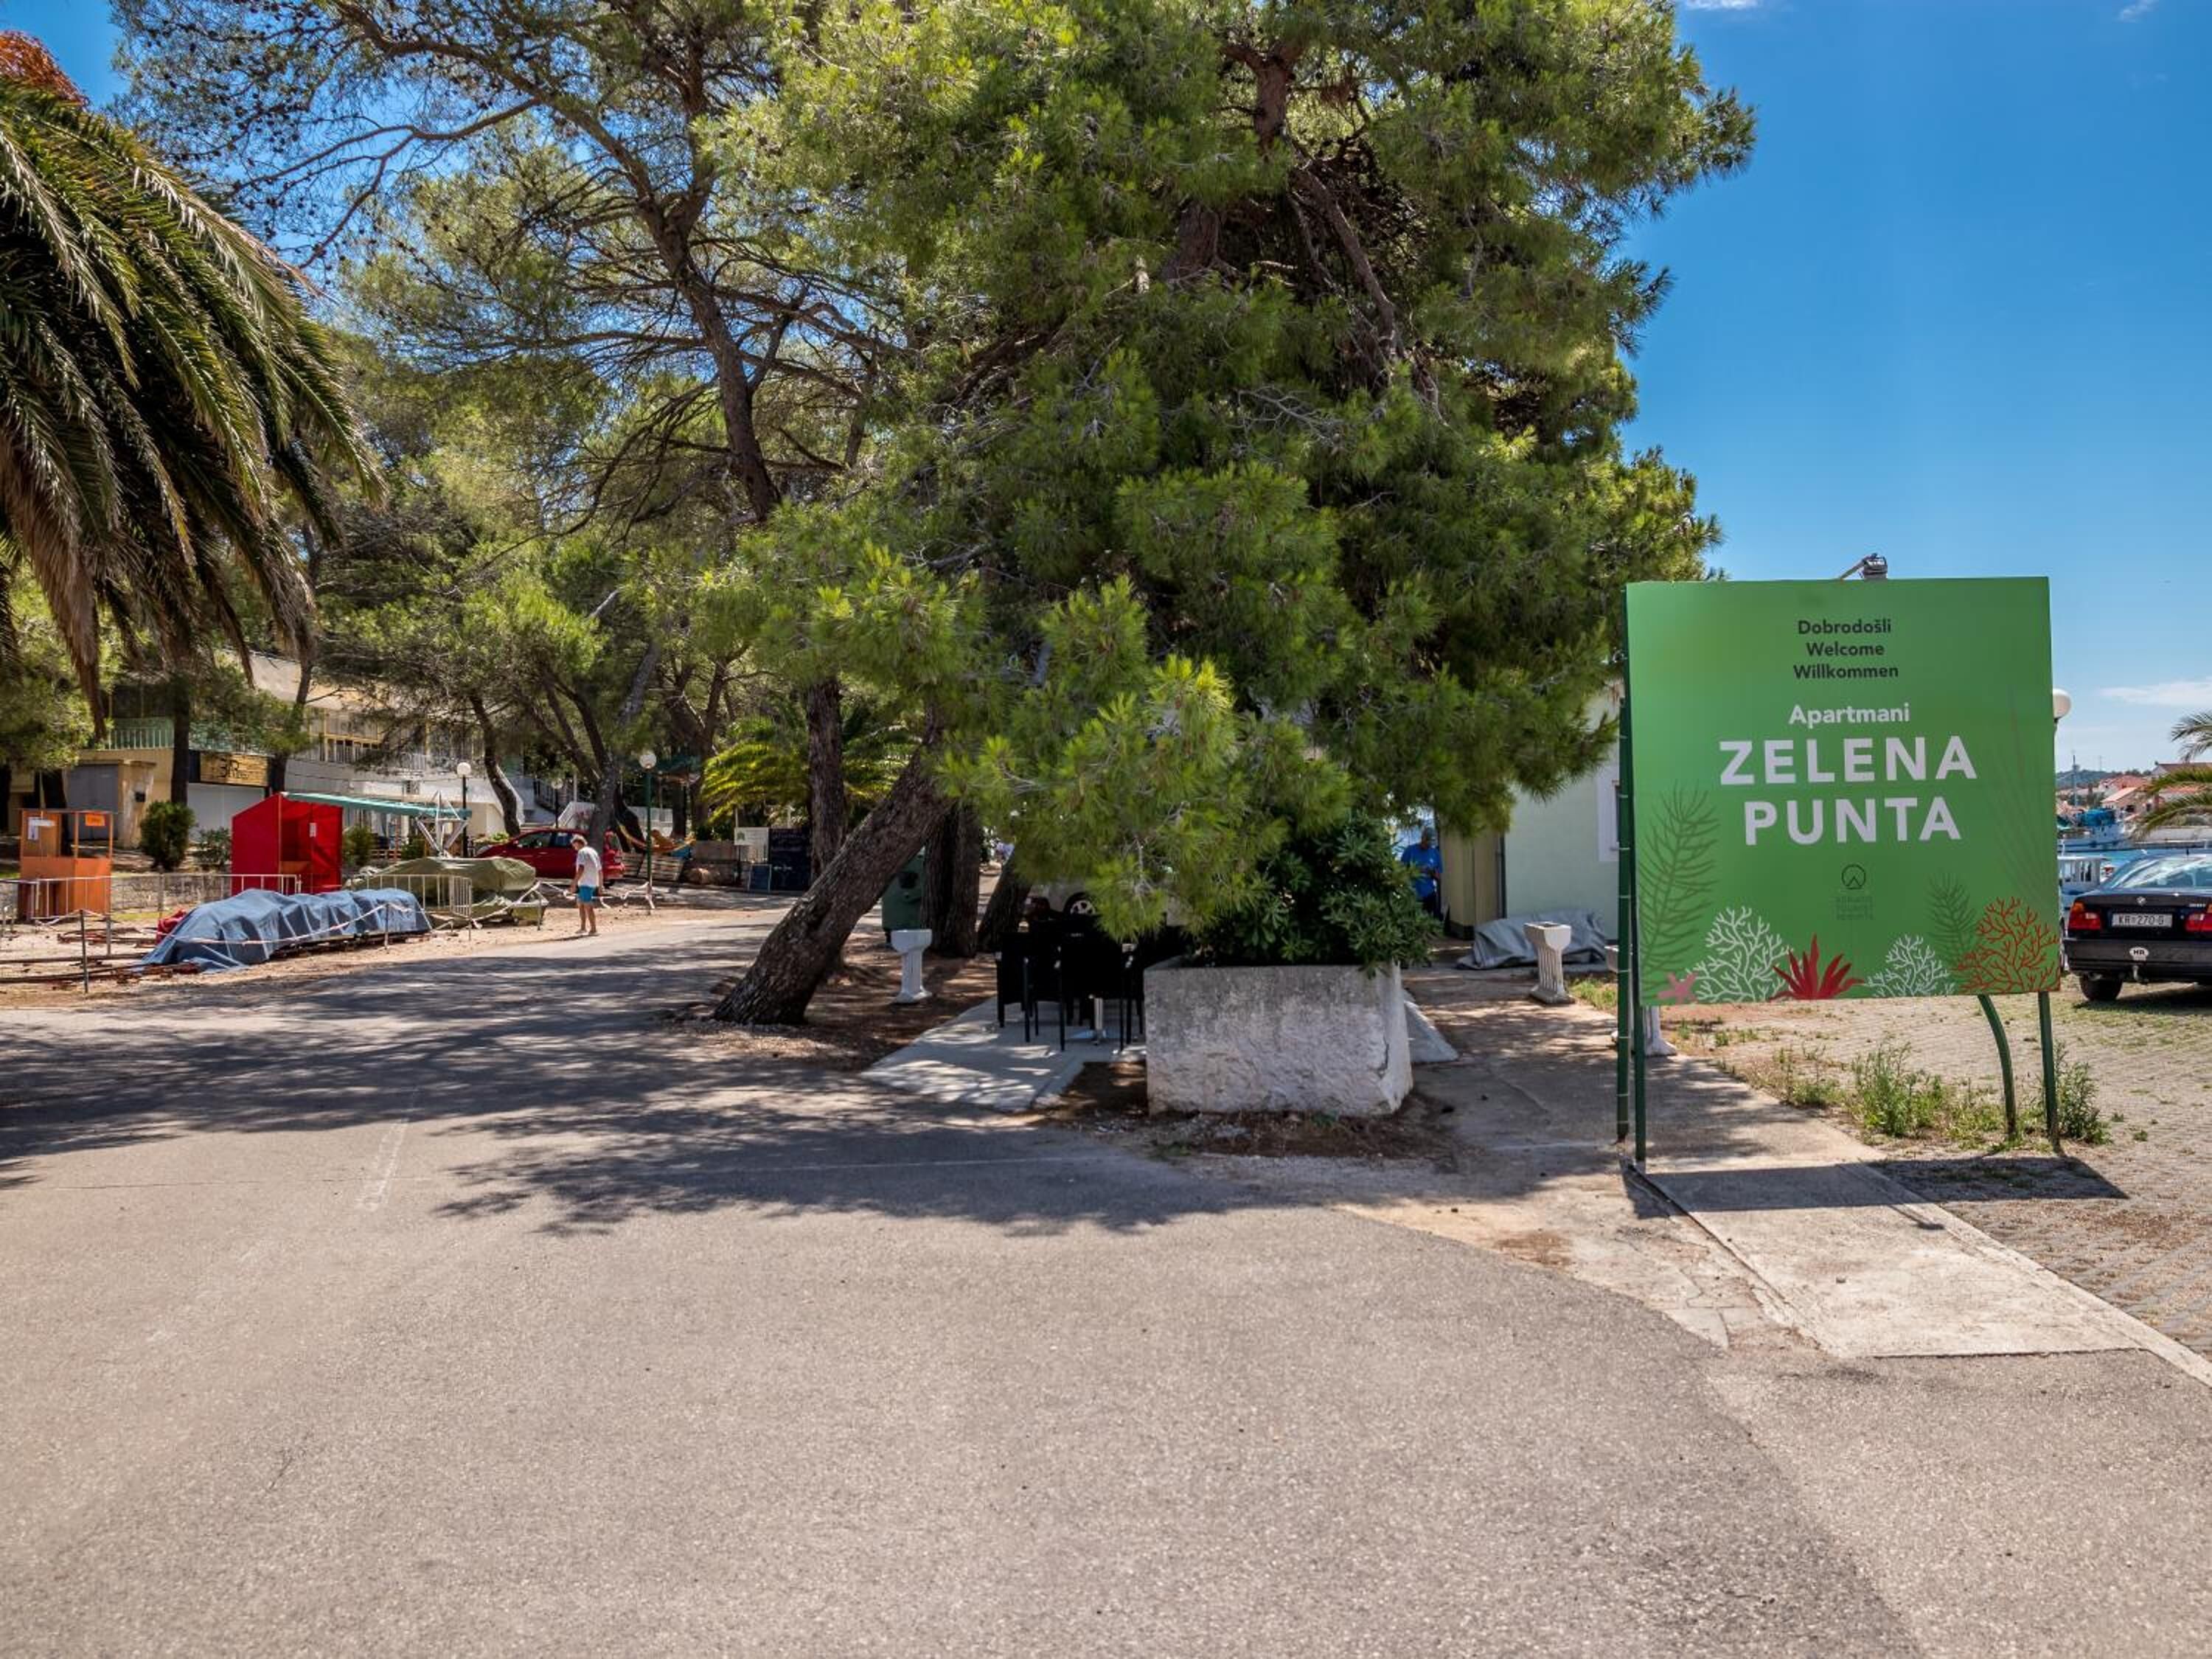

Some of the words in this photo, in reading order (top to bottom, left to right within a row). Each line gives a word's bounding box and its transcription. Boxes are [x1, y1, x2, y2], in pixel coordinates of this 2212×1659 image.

[1798, 619, 1891, 634] Dobrodošli
[1806, 641, 1885, 657] Welcome
[1792, 664, 1899, 679] Willkommen
[1788, 702, 1910, 729] Apartmani
[1719, 735, 1978, 785] ZELENA
[1744, 796, 1961, 846] PUNTA
